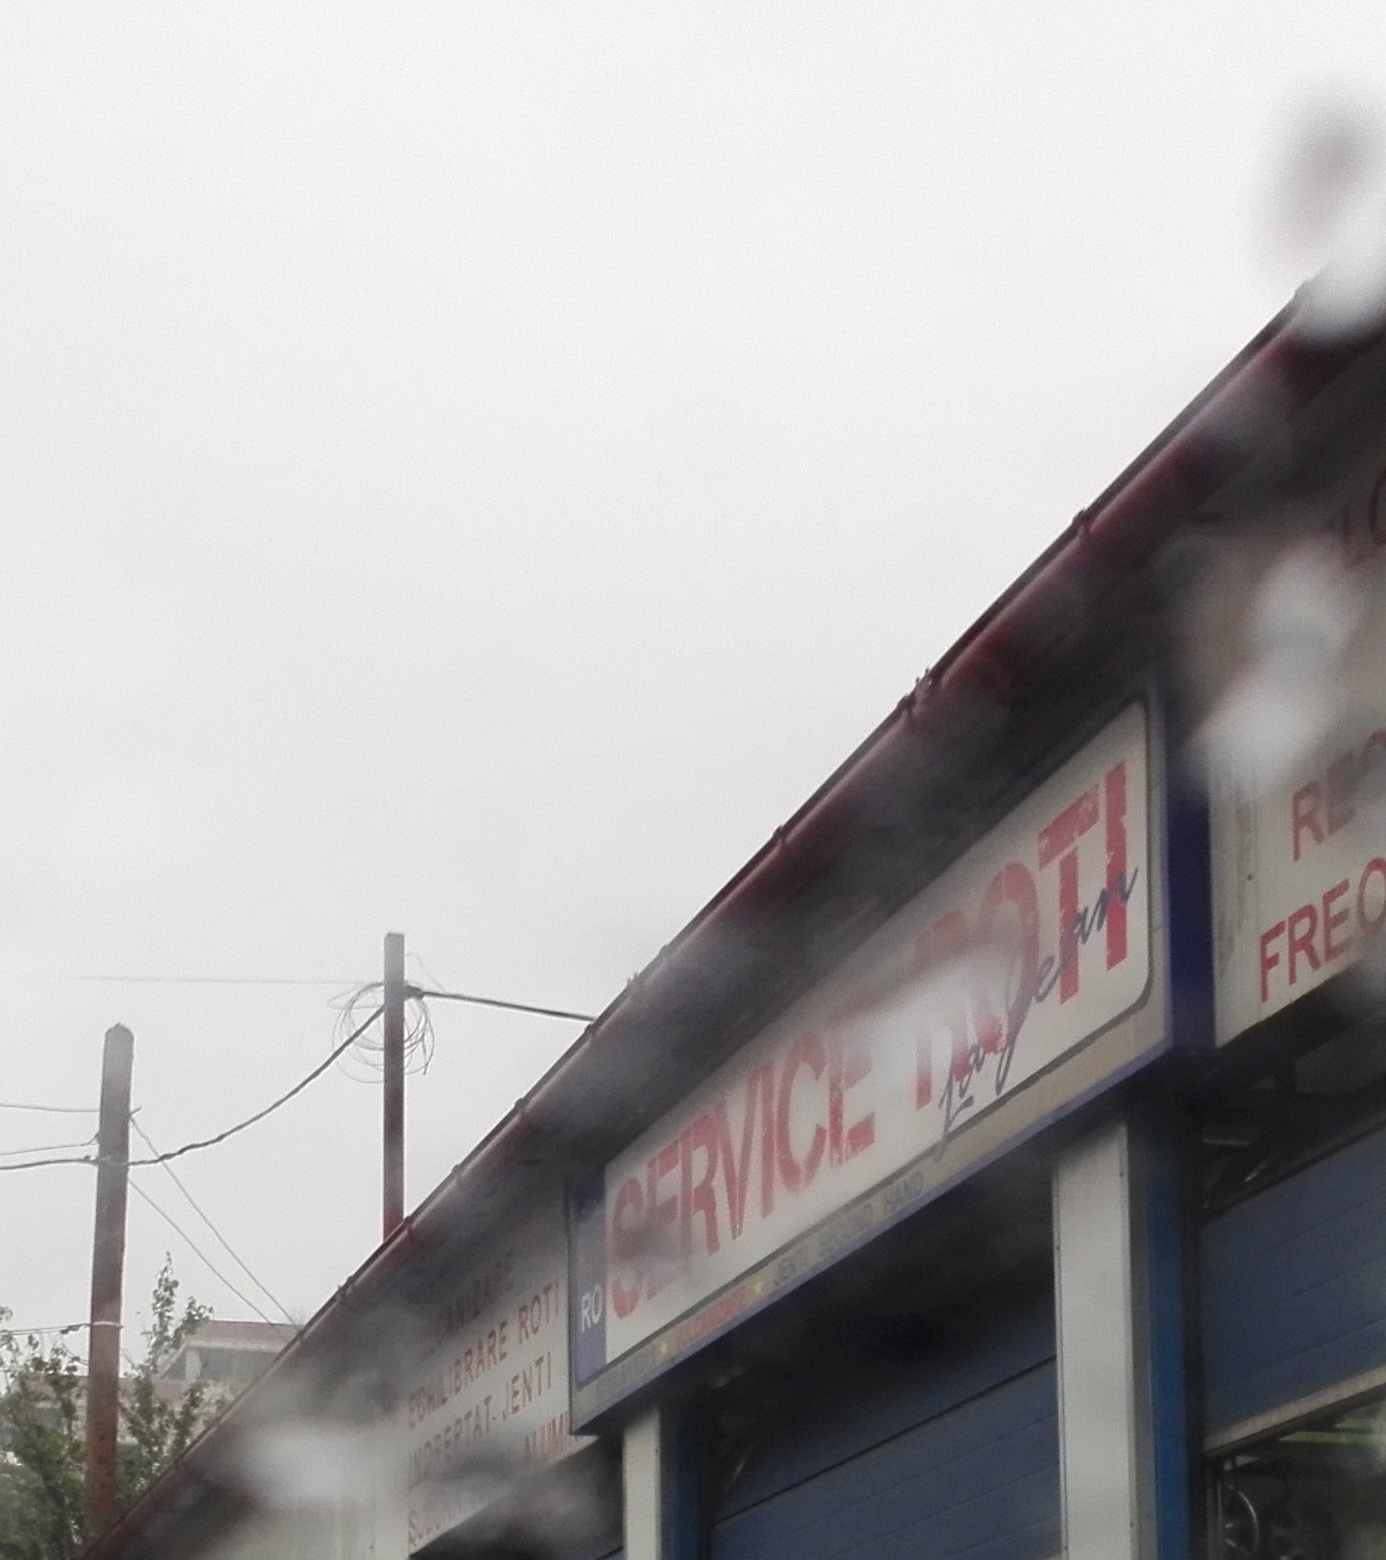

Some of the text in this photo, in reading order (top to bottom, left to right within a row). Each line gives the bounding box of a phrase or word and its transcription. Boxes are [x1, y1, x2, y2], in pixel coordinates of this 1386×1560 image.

[612, 1015, 876, 1320] SERVICE
[518, 1280, 560, 1344] ROTI
[580, 1283, 604, 1334] RO
[501, 1351, 551, 1421] JENTI
